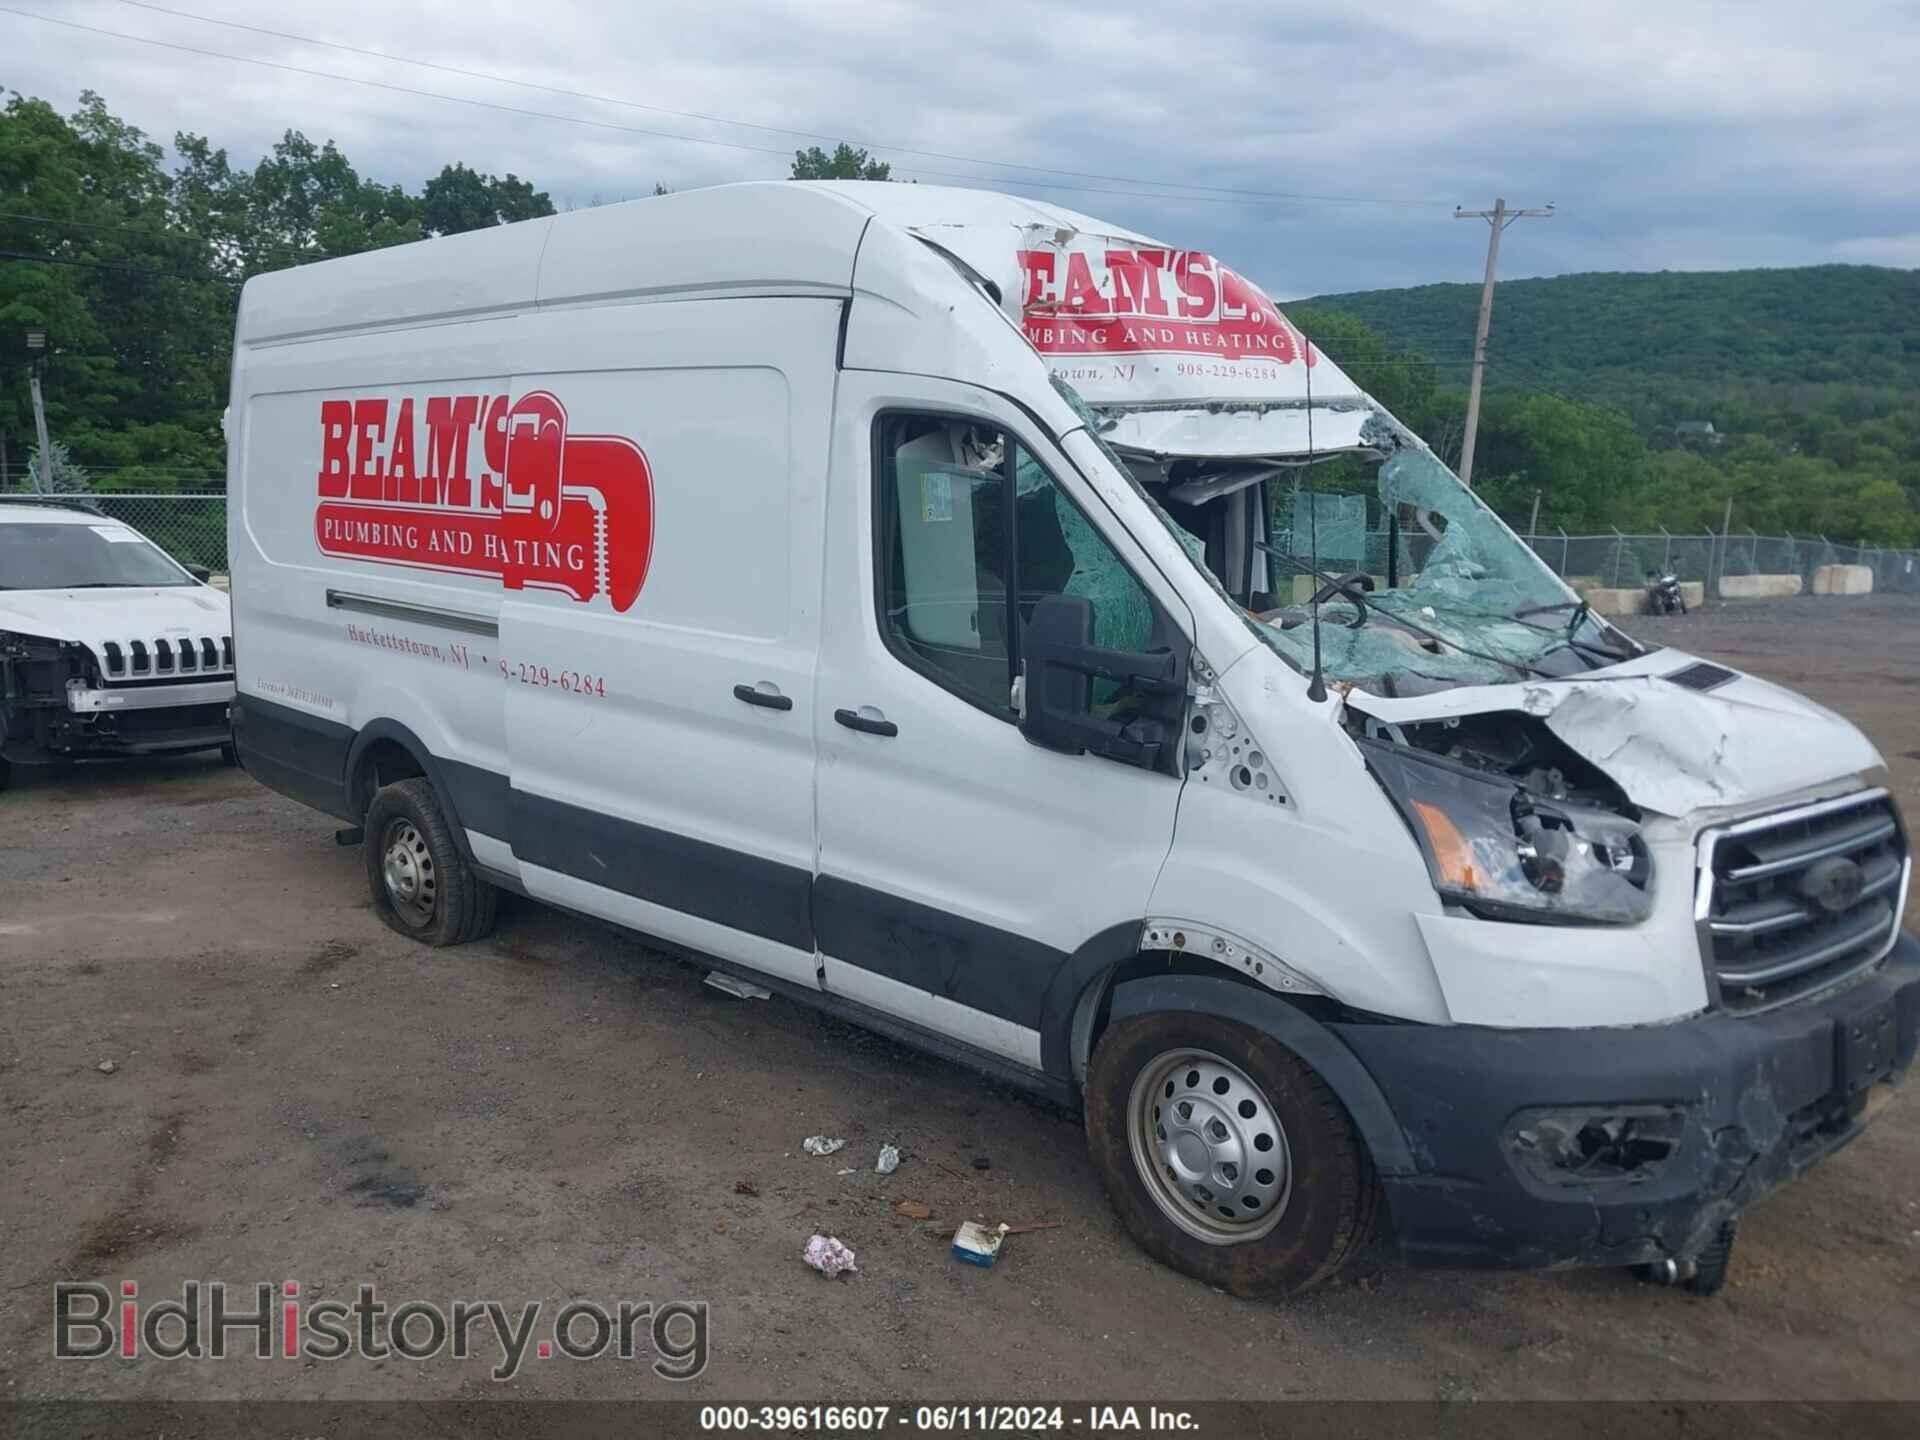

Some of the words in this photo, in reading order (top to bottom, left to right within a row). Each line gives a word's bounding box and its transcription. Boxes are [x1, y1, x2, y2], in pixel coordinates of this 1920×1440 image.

[1017, 250, 1219, 319] EAM'S
[1023, 322, 1107, 344] MBING
[1123, 327, 1175, 344] AND
[1186, 329, 1285, 350] HEATING
[1051, 367, 1104, 380] town,
[1113, 364, 1137, 381] NJ
[1177, 363, 1277, 380] 908-229-6284
[318, 395, 509, 510] BEAM'S
[324, 518, 419, 549] PLUMBING
[428, 529, 473, 555] AND
[484, 533, 584, 571] HATING
[450, 643, 470, 671] NJ
[499, 659, 606, 697] 8-229-6284
